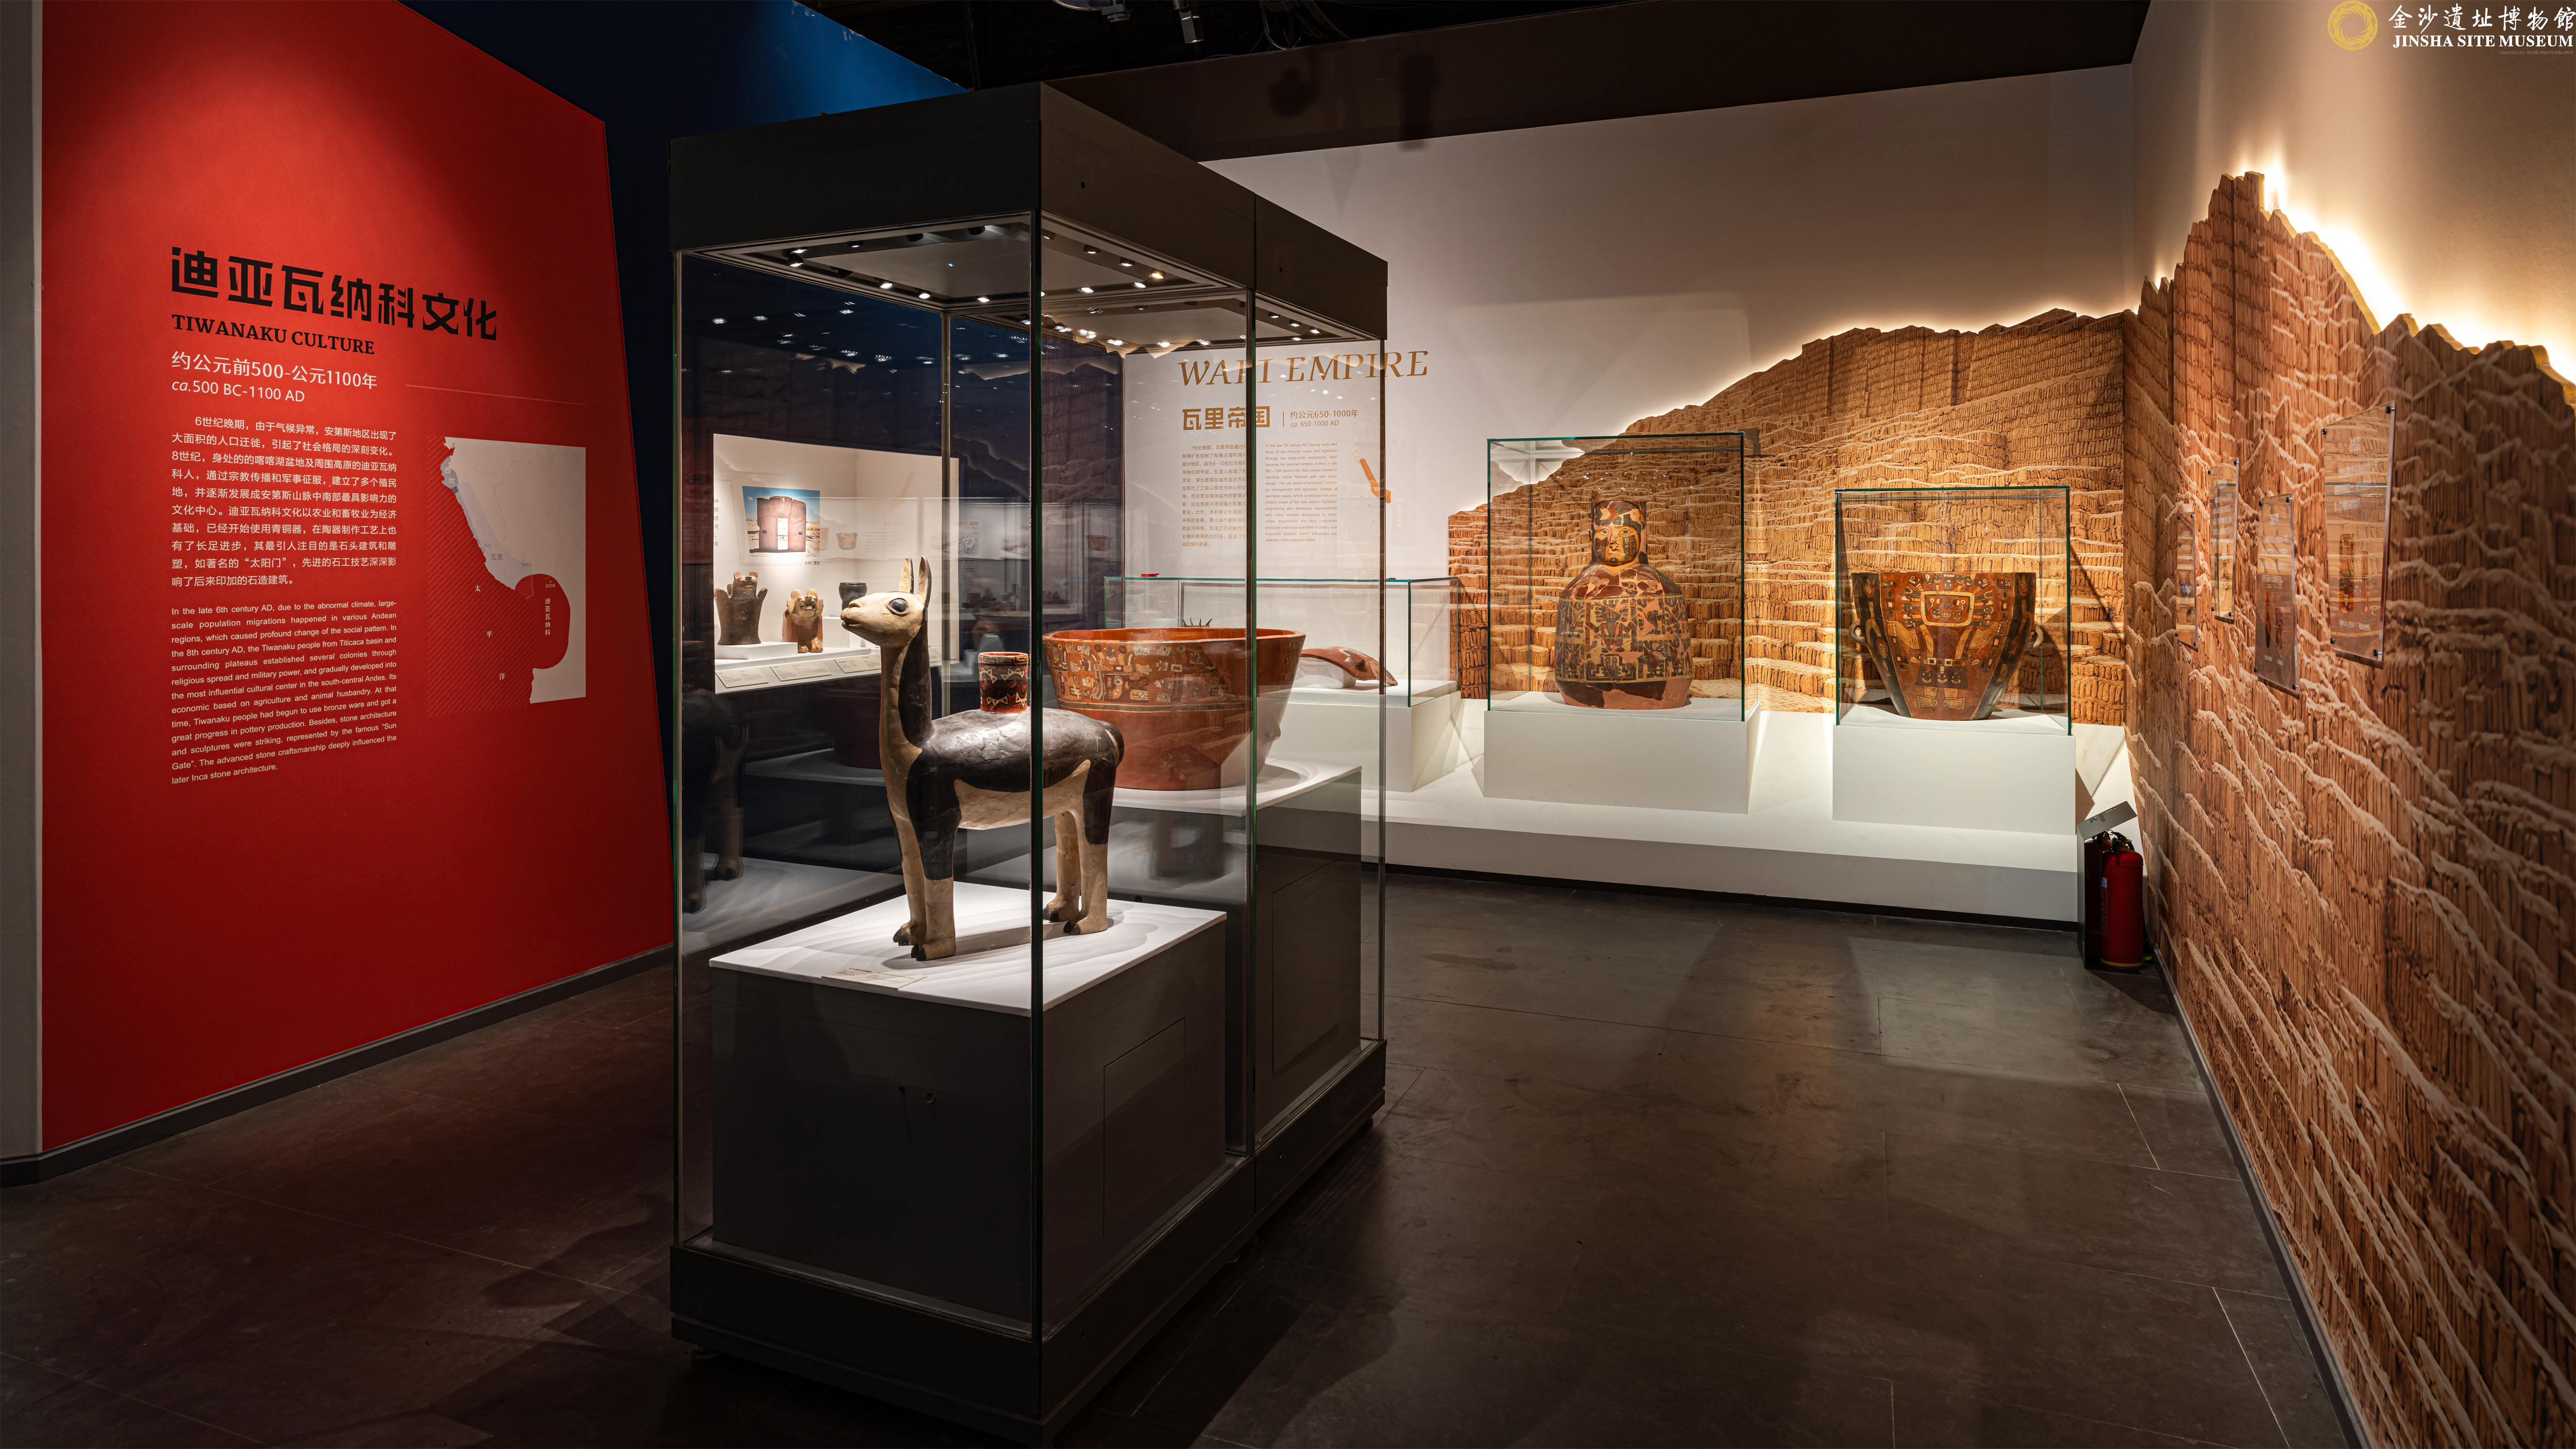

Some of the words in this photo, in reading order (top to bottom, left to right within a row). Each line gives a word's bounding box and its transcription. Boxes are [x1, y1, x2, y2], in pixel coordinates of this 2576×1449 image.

[172, 247, 497, 341] 迪亚瓦纳科文化
[172, 314, 287, 344] TIWANAKU
[291, 330, 375, 355] CULTURE
[172, 350, 378, 390] 约公元前500-公元1100年
[1284, 350, 1429, 382] EMPIRE
[285, 390, 305, 402] AD
[1182, 406, 1270, 430] 瓦里帝国
[1290, 409, 1359, 419] 约公元650-1000年
[261, 604, 275, 612] AD,
[199, 619, 241, 629] population
[246, 617, 286, 627] migrations
[291, 615, 327, 624] happened
[172, 635, 203, 645] regions,
[230, 631, 258, 640] caused
[260, 630, 292, 640] profound
[364, 626, 388, 634] pattern.
[261, 643, 295, 651] Tiwanaku
[297, 641, 320, 651] people
[172, 662, 219, 671] surrounding
[225, 660, 258, 669] plateaus
[263, 655, 304, 665] established
[310, 653, 335, 661] several
[372, 649, 397, 657] through
[172, 677, 205, 686] religious
[207, 673, 233, 684] spread
[279, 670, 302, 678] power,
[318, 665, 349, 675] gradually
[350, 662, 383, 671] developed
[233, 765, 278, 776] architecture.
